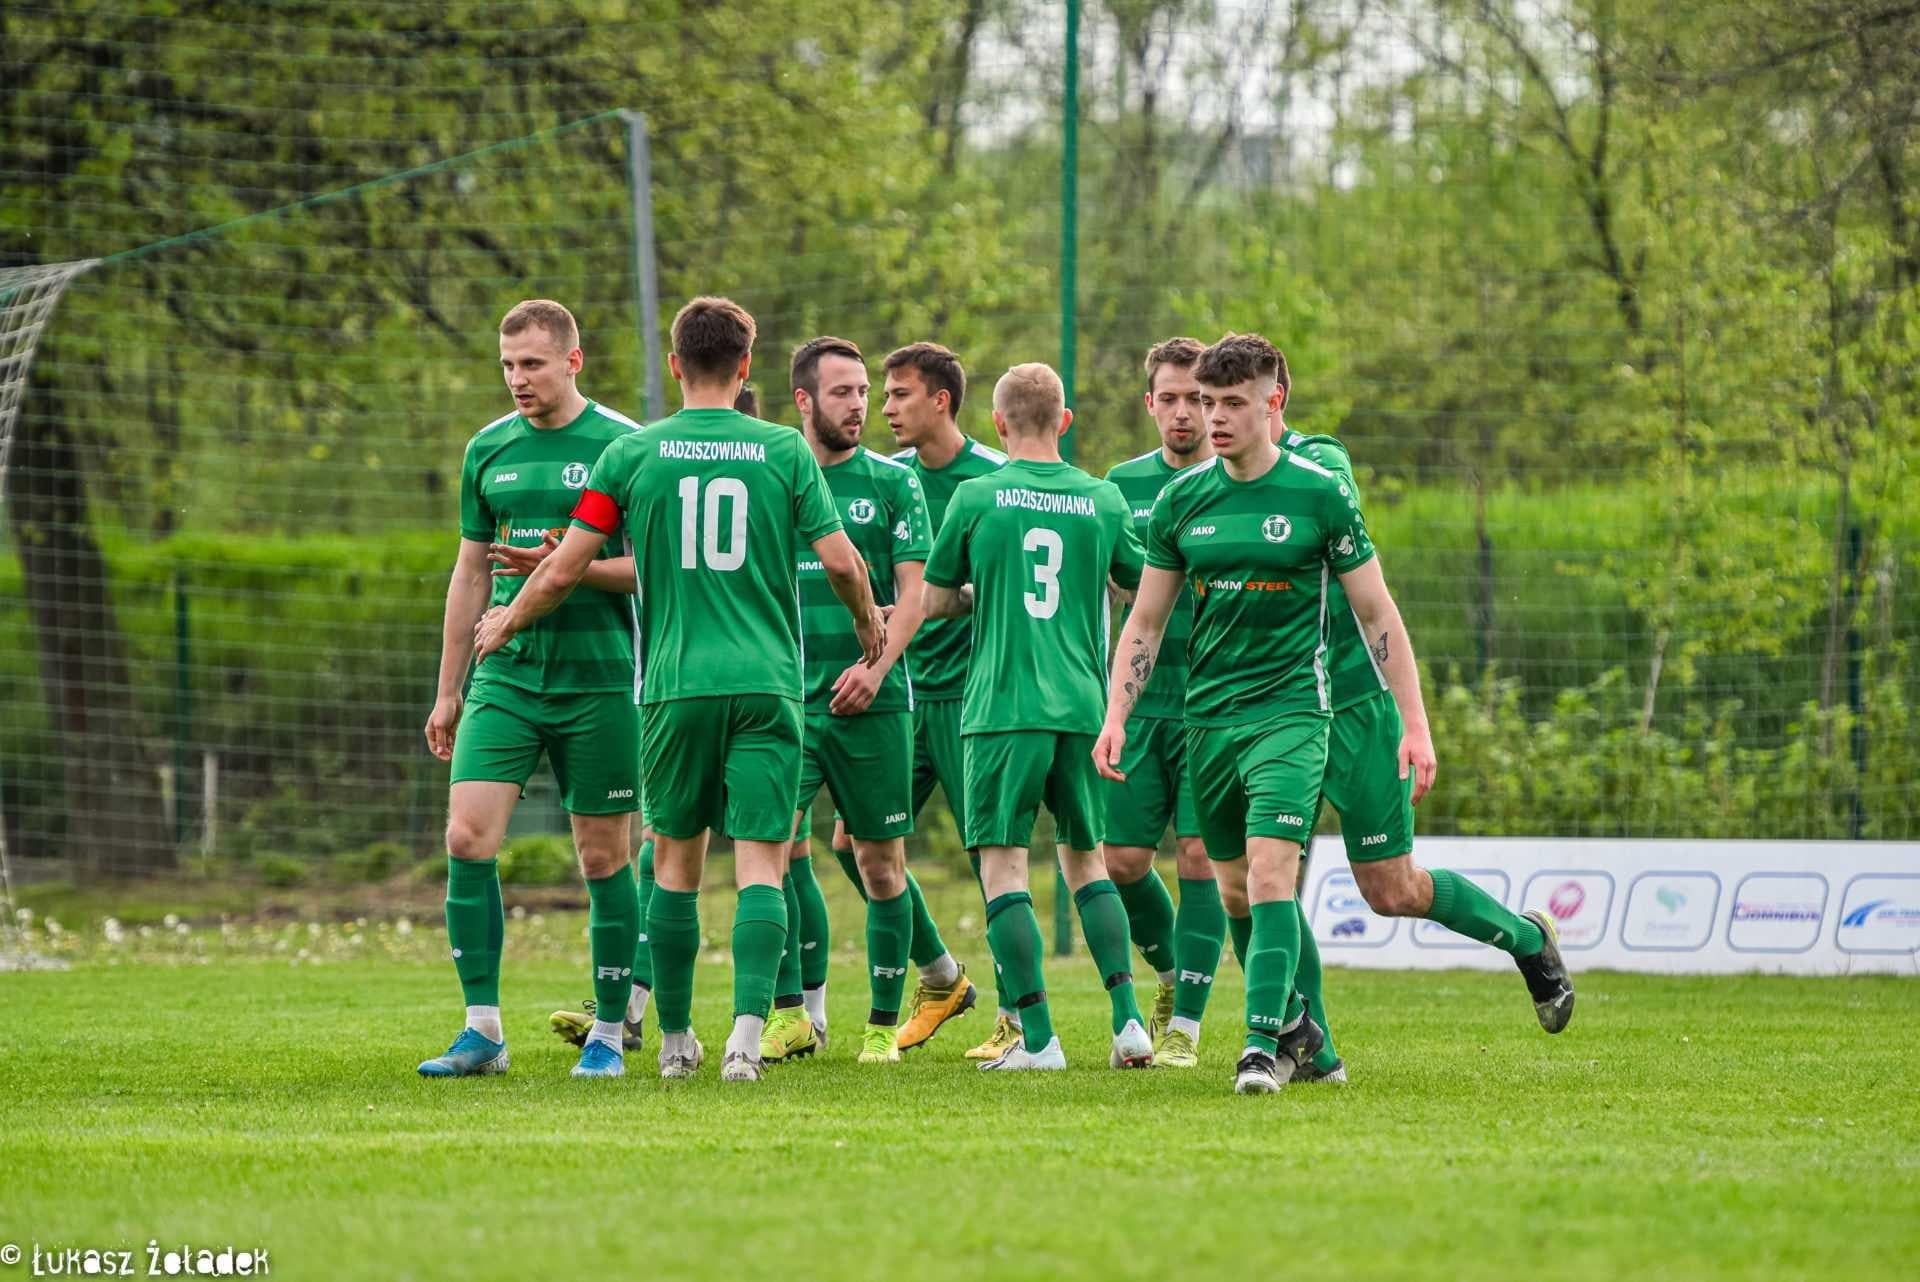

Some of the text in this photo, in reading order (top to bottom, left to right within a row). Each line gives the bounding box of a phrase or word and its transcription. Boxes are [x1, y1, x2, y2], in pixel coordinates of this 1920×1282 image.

[659, 440, 766, 462] RADZISZOWIANKA
[494, 472, 518, 483] JAKO
[995, 488, 1096, 517] RADZISZOWIANKA
[1133, 507, 1152, 518] JAK
[678, 476, 748, 571] 10
[1190, 525, 1216, 537] JAKO
[1023, 527, 1064, 620] 3
[1244, 580, 1294, 592] STEEL
[607, 789, 634, 800] JAKO
[884, 812, 907, 825] JAKO
[1276, 814, 1303, 827] JAKO
[1361, 833, 1388, 846] JAKO
